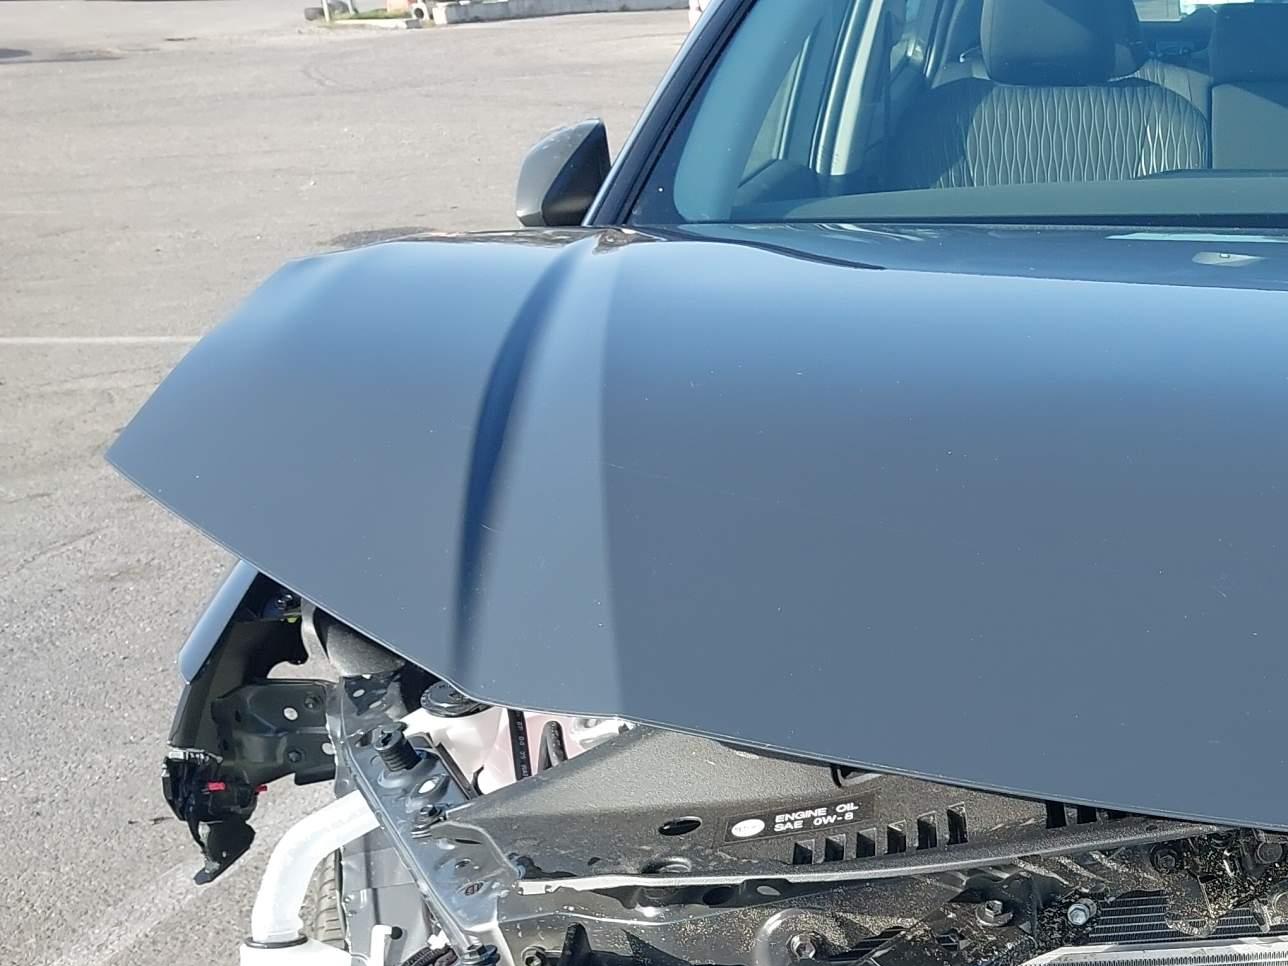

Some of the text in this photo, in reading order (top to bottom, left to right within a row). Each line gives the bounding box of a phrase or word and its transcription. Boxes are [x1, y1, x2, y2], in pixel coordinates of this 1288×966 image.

[773, 820, 803, 832] SAE
[813, 812, 854, 826] 0W-8
[775, 802, 859, 823] ENGINE OIL
